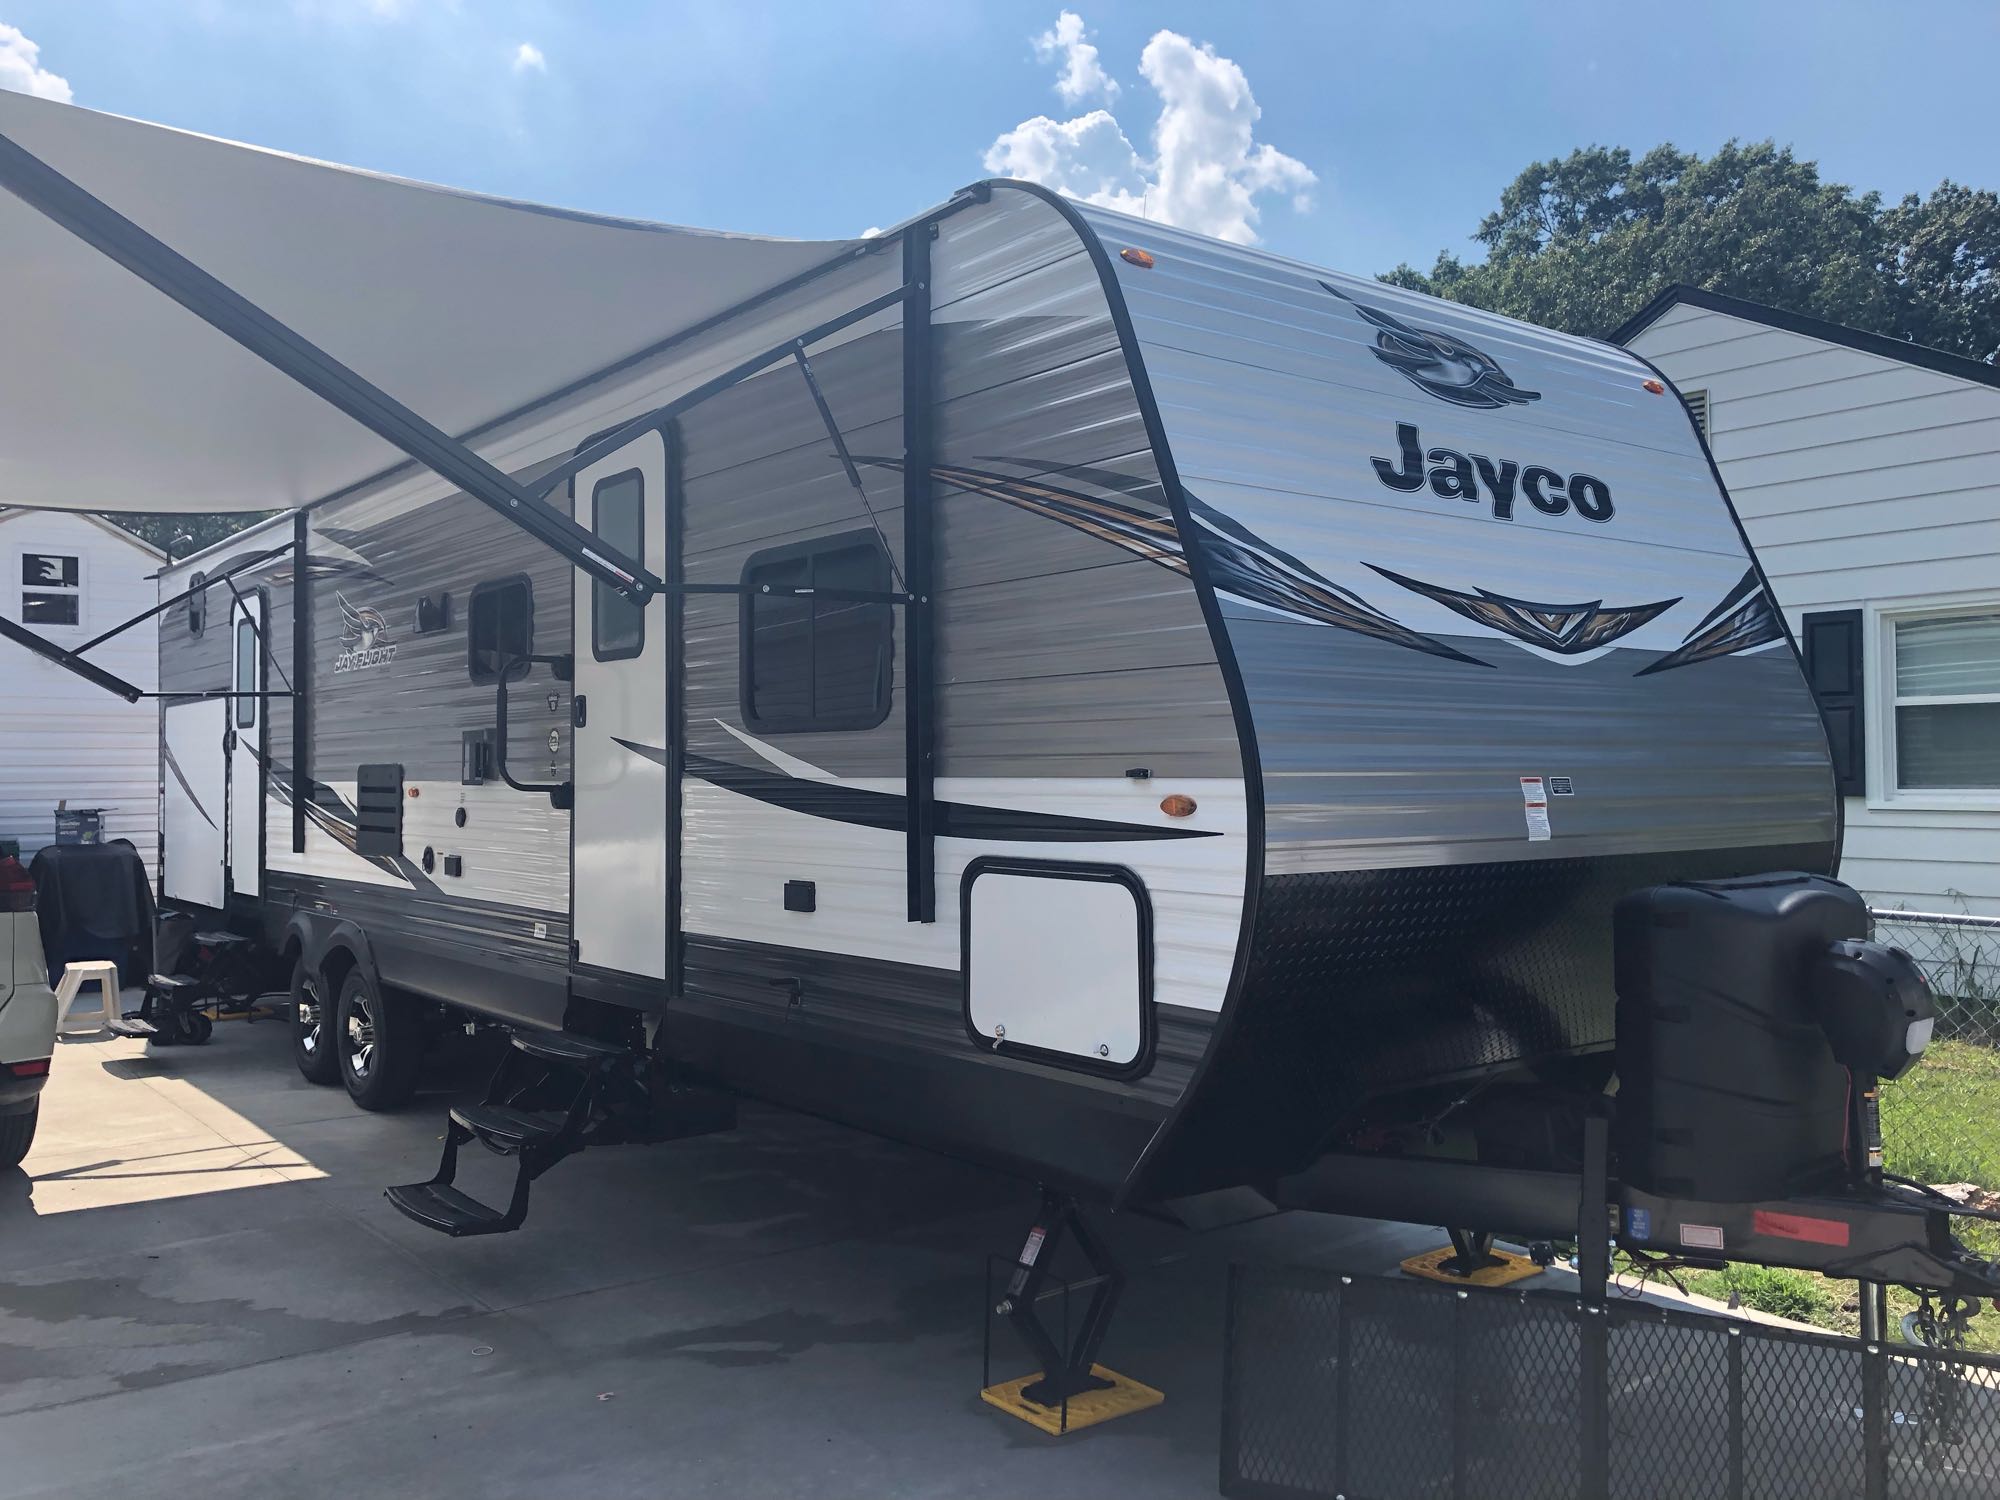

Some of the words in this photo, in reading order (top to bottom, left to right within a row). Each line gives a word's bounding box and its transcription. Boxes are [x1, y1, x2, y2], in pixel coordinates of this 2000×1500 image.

[1370, 421, 1616, 523] Jayco
[334, 653, 356, 673] JAY
[355, 645, 397, 669] FLIGHT
